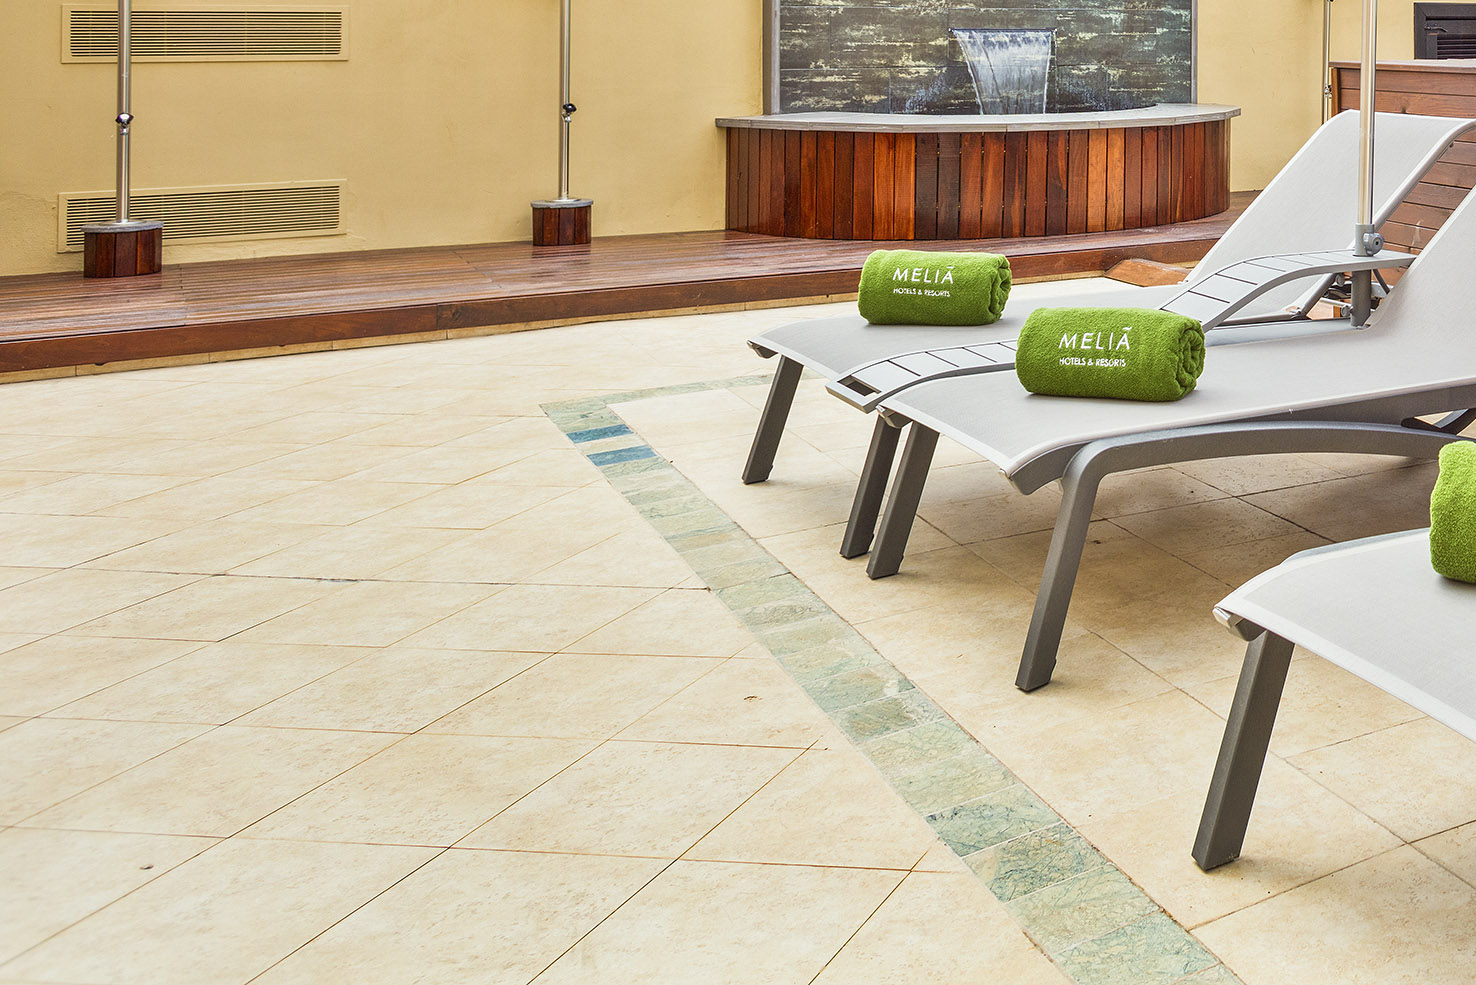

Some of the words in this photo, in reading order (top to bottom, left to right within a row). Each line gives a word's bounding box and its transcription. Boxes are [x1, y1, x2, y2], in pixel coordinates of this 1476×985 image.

[893, 287, 917, 295] HOTELS
[924, 289, 951, 297] RESORTS
[1059, 357, 1086, 366] HOTELS
[1087, 358, 1094, 366] &
[1095, 358, 1127, 367] RESORTS
